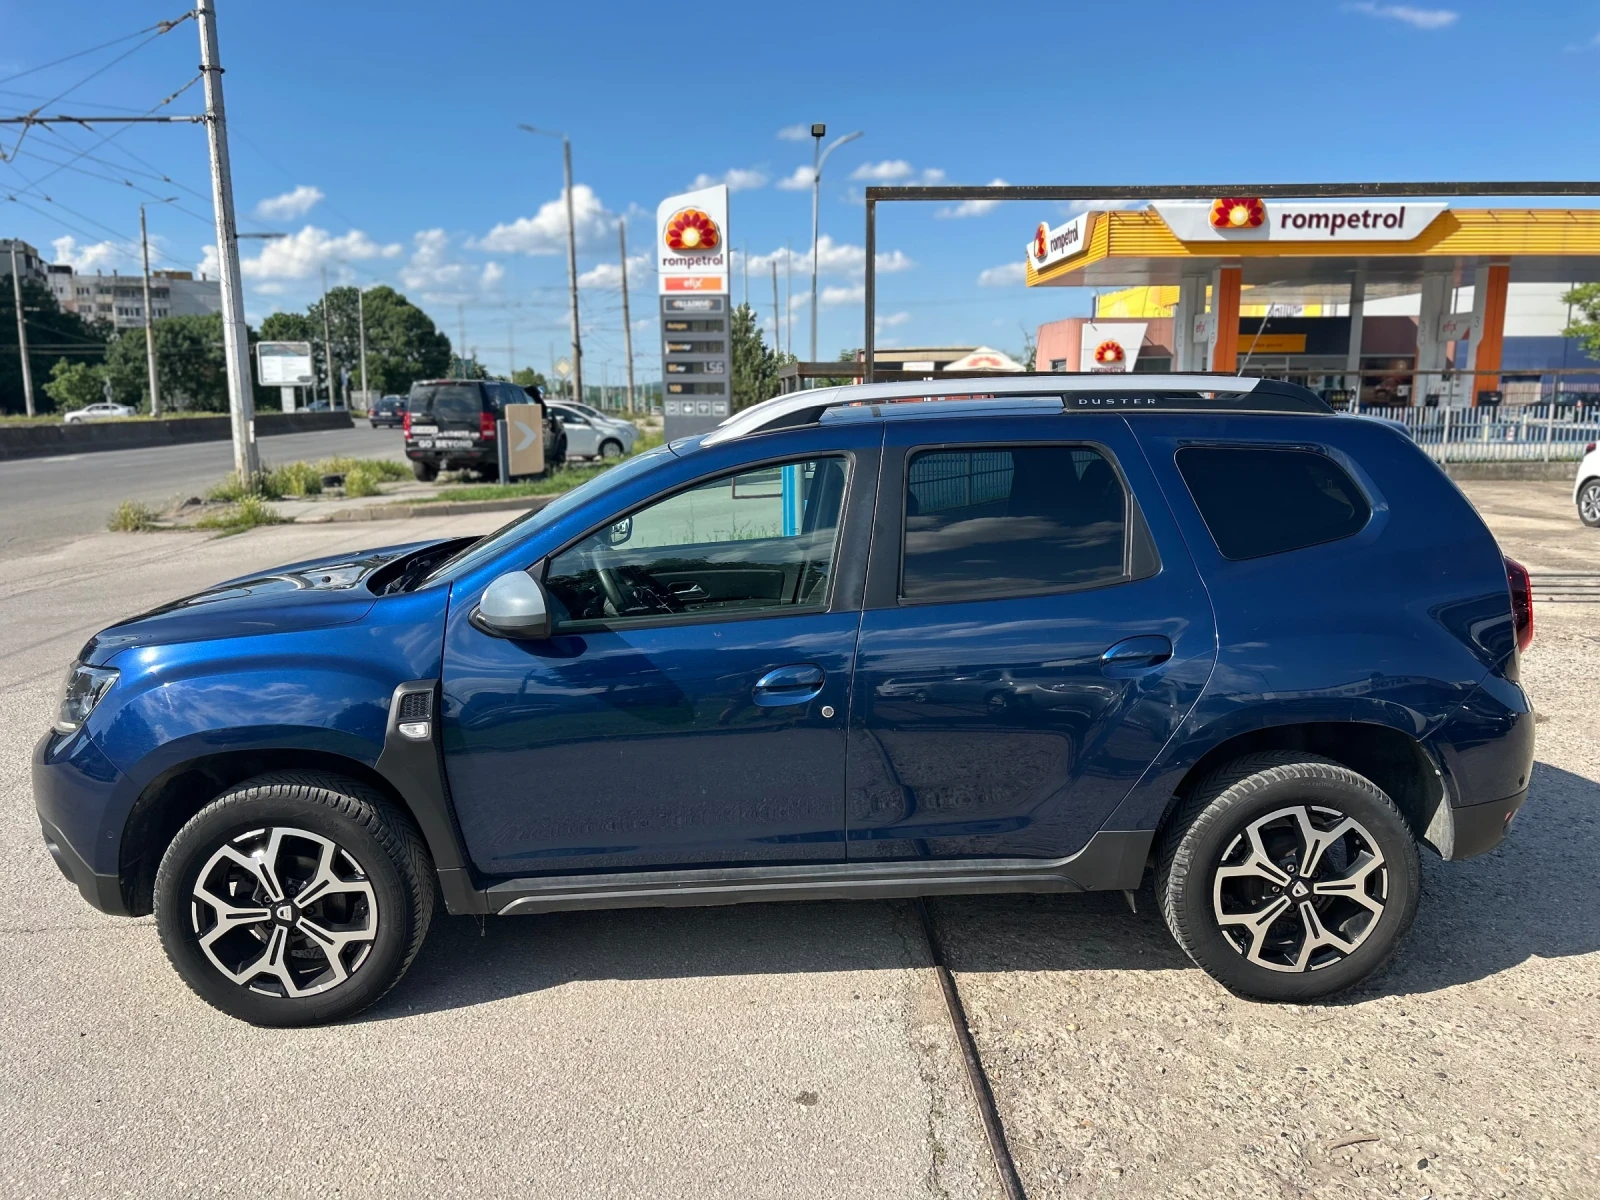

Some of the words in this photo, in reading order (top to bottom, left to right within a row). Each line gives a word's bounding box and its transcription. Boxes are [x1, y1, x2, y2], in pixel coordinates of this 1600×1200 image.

[1280, 205, 1405, 236] rompetrol
[1050, 220, 1079, 254] rompetrol
[662, 253, 723, 269] rompetrol
[418, 440, 432, 448] GO
[435, 440, 473, 448] BEYOND
